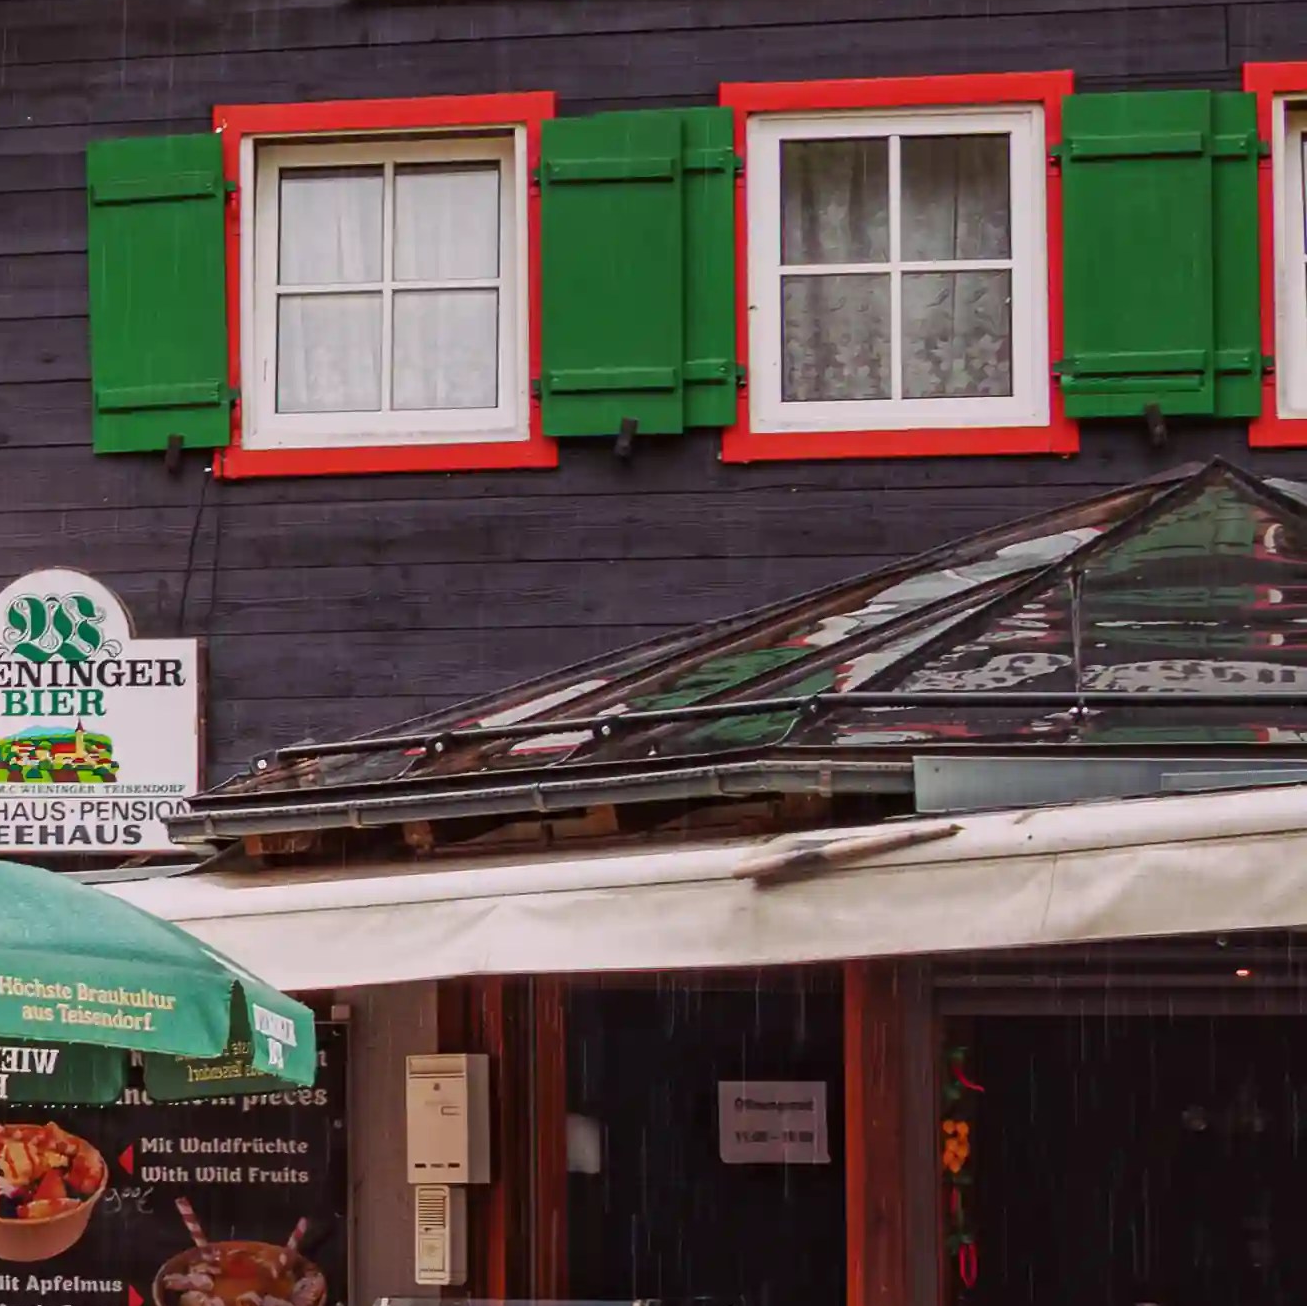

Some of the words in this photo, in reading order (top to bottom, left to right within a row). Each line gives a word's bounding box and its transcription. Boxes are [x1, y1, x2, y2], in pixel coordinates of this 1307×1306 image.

[0, 689, 107, 717] BIER
[76, 981, 177, 1011] Braukultur
[22, 1004, 54, 1022] aus
[141, 1138, 176, 1154] Mit
[180, 1137, 309, 1155] Waldfrüchte
[140, 1167, 189, 1183] With
[195, 1166, 242, 1183] Wild
[247, 1167, 310, 1184] Fruits
[26, 1274, 123, 1296] Apfelmus
